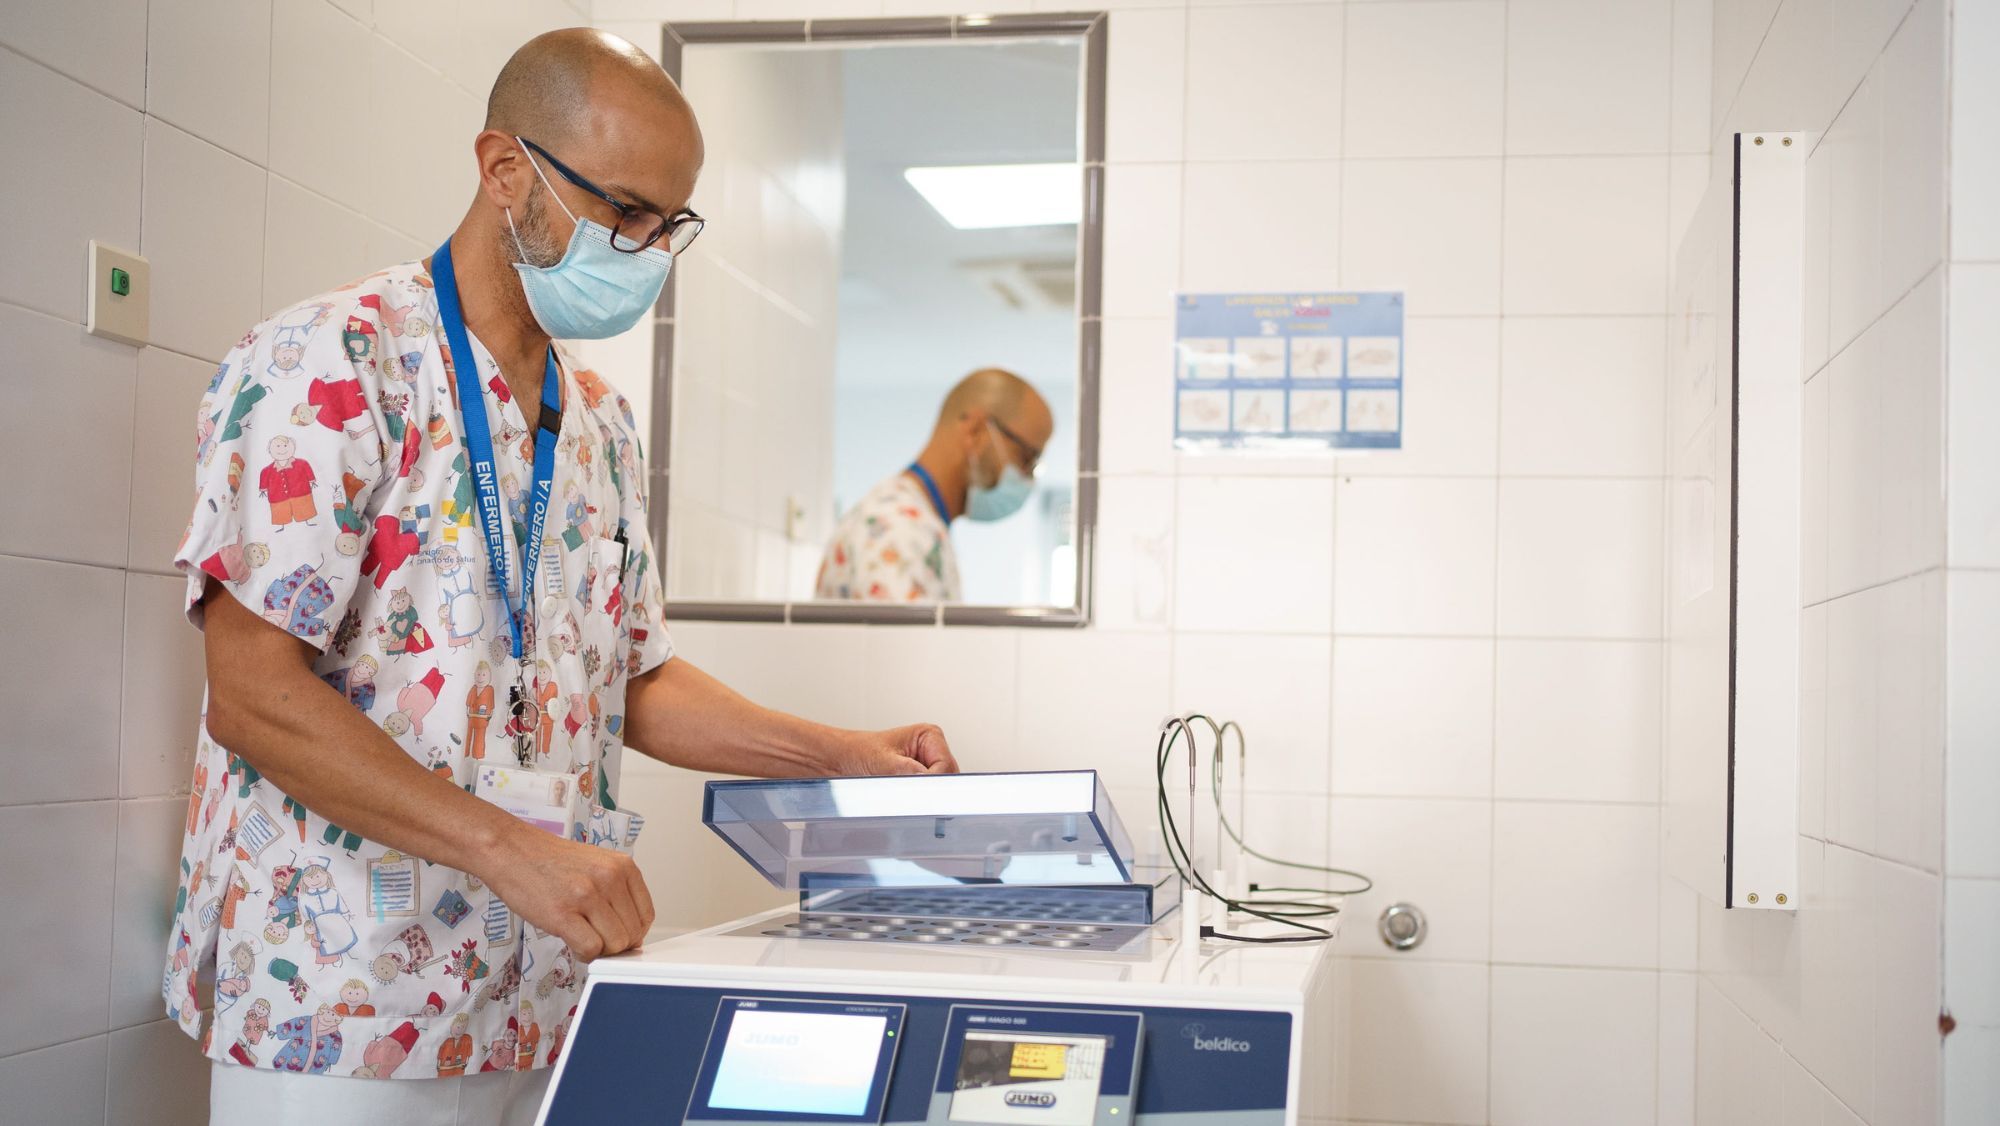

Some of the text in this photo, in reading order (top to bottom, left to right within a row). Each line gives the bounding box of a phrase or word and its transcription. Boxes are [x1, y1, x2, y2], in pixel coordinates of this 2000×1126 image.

[475, 461, 505, 571] ENFERMERO
[456, 555, 476, 563] Salud
[744, 1031, 800, 1046] JUMO
[1194, 1035, 1250, 1052] beldico
[1008, 1093, 1050, 1105] JUMO
